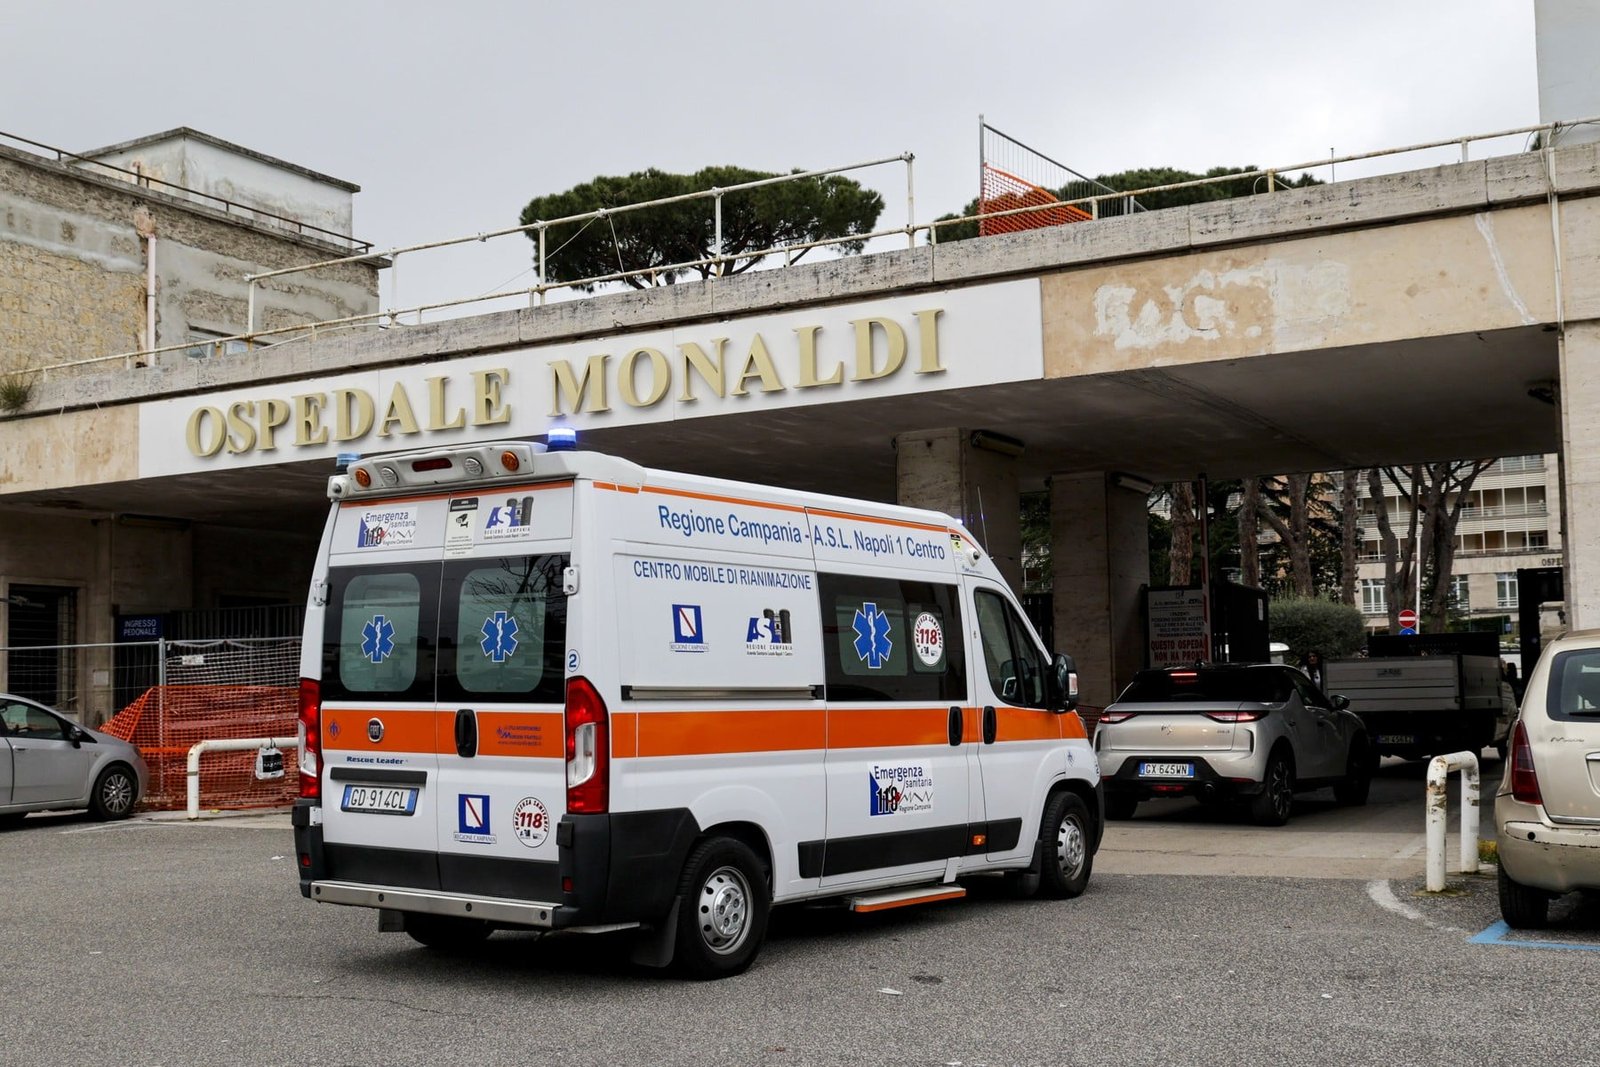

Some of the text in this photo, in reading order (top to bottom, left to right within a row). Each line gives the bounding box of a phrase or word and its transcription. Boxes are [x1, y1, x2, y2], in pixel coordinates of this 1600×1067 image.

[185, 308, 948, 457] OSPEDALE MONALDI
[365, 512, 409, 524] Emergenza
[390, 520, 416, 528] sanitaria
[364, 527, 383, 545] 118
[658, 505, 725, 538] Regione
[728, 513, 803, 545] Campania
[813, 525, 853, 550] A.S.L.
[854, 531, 895, 558] Napoli
[896, 536, 903, 554] 1
[905, 537, 946, 560] Centro
[1541, 557, 1563, 566] OSPE
[633, 560, 811, 590] CENTRO MOBILE DI RIANIMAZIONE
[124, 618, 157, 628] INGRESSO
[123, 627, 157, 636] PEDONALE
[919, 628, 938, 645] 118
[1151, 639, 1204, 651] QUESTO OSPEDA
[568, 653, 577, 668] 2
[1154, 650, 1204, 662] NON HA PRONT
[376, 757, 404, 765] Leader
[874, 766, 923, 782] Emergenza
[1159, 764, 1187, 775] 645WN
[905, 777, 933, 788] sanitaria
[350, 788, 406, 810] GD 914CL
[876, 786, 898, 813] 118
[519, 811, 543, 829] 118
